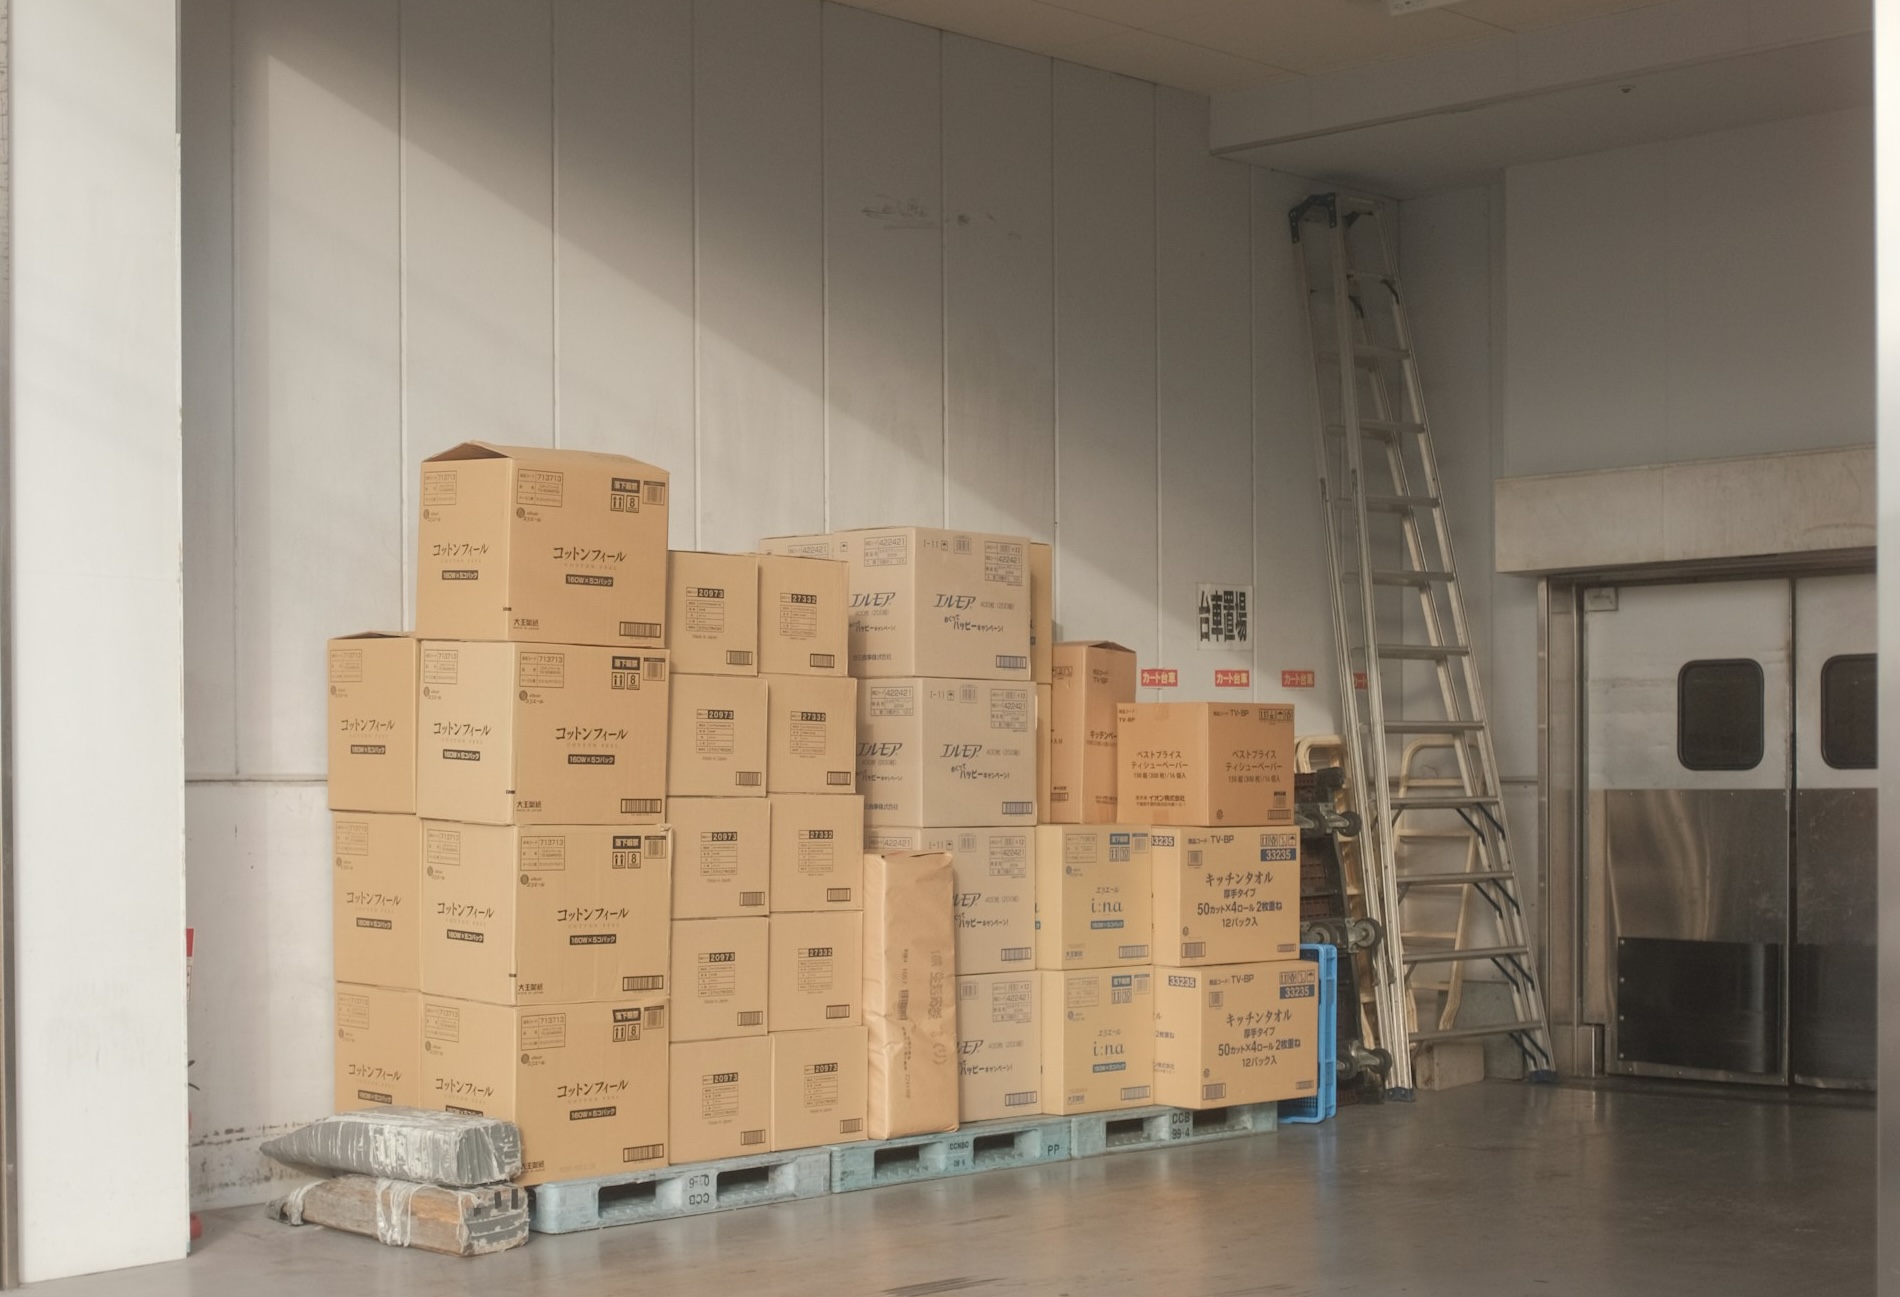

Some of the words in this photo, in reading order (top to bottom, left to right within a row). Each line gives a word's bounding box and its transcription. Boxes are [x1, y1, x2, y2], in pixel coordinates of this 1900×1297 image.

[629, 498, 636, 508] 8
[879, 538, 904, 546] 422421
[432, 542, 489, 557] コットンフィール
[552, 546, 626, 562] コットンフィール
[802, 545, 827, 554] 422421
[698, 588, 724, 598] 20973
[792, 594, 816, 604] 27332
[850, 592, 896, 608] エルモア
[933, 593, 976, 610] エルモア
[1198, 590, 1248, 642] 台車置場
[538, 655, 562, 664] 713713
[630, 674, 636, 685] 8
[1142, 672, 1176, 684] カート台車
[1216, 672, 1248, 684] カート台車
[1284, 673, 1314, 685] カート台車
[885, 689, 912, 697] 422421
[1004, 702, 1026, 710] 422421
[708, 711, 734, 719] 20973
[802, 713, 826, 721] 27332
[341, 718, 395, 731] コットンフィール
[434, 721, 492, 736] コットンフィール
[555, 726, 628, 741] コットンフィール
[858, 742, 902, 757] エルモア
[940, 744, 982, 758] エルモア
[1138, 751, 1182, 759] ベストプライス
[1232, 750, 1276, 759] ベストプライス
[1132, 762, 1188, 770] ティシューペーパー
[1226, 763, 1282, 772] ティシューペーパー
[712, 832, 737, 840] 20973
[1210, 835, 1234, 844] TV-BP
[630, 853, 637, 864] 8
[1266, 850, 1291, 860] 33235
[1206, 871, 1273, 887] キッチンタオル
[346, 891, 402, 906] コットンフィール
[1224, 888, 1256, 898] 厚手タイプ
[437, 902, 495, 918] コットンフィール
[557, 908, 630, 922] コットンフィール
[1222, 917, 1258, 928] 12パック入
[710, 954, 734, 962] 20973
[1170, 976, 1194, 988] 33235
[1231, 974, 1254, 984] TV-BP
[1284, 986, 1310, 998] 33235
[1226, 1009, 1292, 1027] キッチンタオル
[630, 1024, 637, 1036] 8
[1244, 1026, 1275, 1038] 厚手タイプ
[1242, 1055, 1278, 1068] 12パック入
[348, 1064, 402, 1080] コットンフィール
[815, 1064, 838, 1072] 20973
[714, 1074, 738, 1083] 20973
[436, 1078, 494, 1097] コットンフィール
[557, 1080, 629, 1098] コットンフィール
[1172, 1112, 1190, 1124] CCB
[1048, 1144, 1060, 1156] PP
